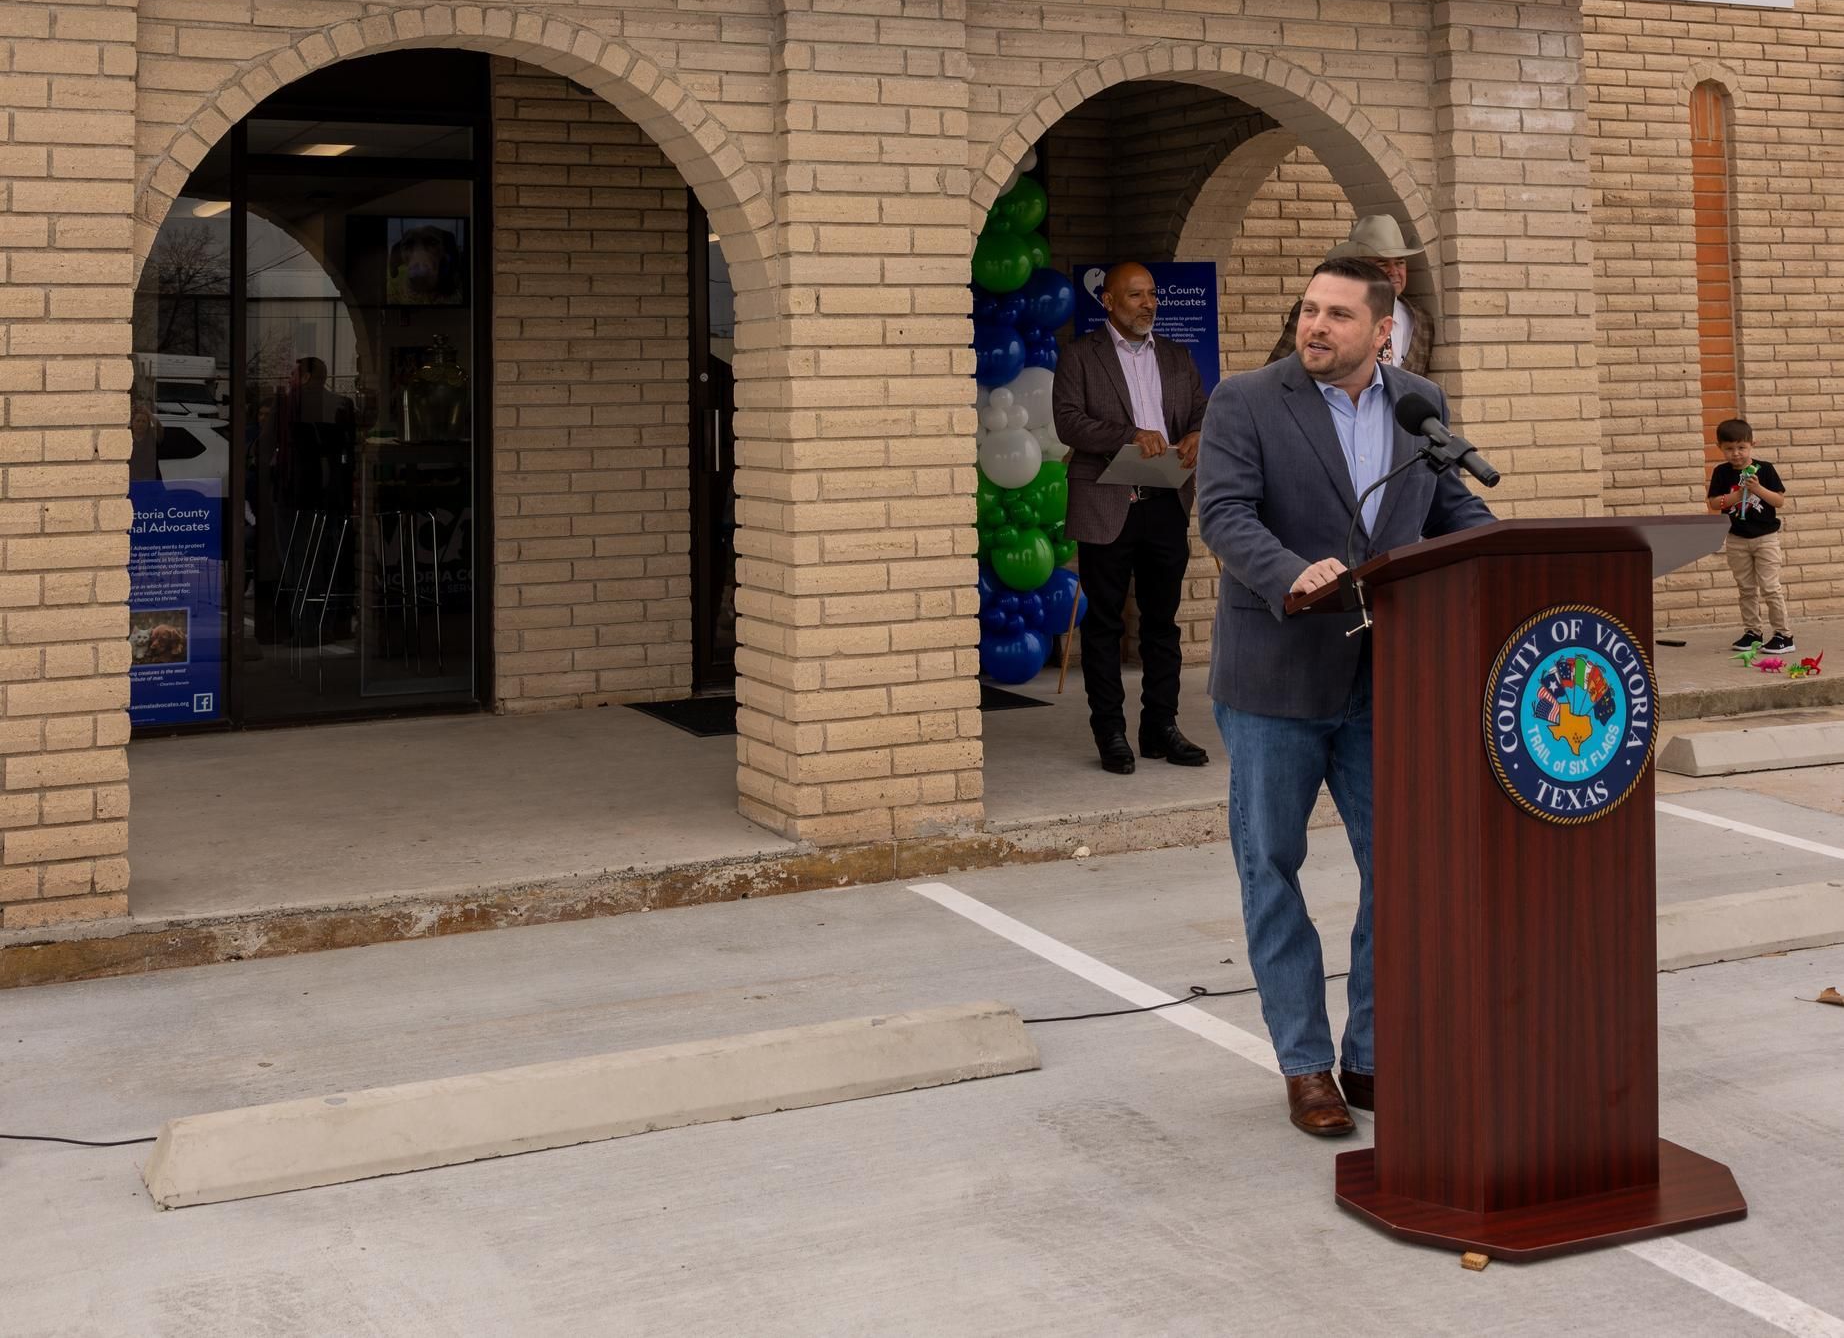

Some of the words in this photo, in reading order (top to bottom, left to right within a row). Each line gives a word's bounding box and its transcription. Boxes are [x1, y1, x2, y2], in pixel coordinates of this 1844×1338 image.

[1169, 285, 1206, 296] County
[1156, 296, 1206, 306] Advocates
[167, 508, 210, 519] County
[149, 521, 210, 532] Advocates
[1497, 634, 1542, 753] COUNTY
[1551, 618, 1583, 643] OF
[1595, 621, 1648, 749] VICTORIA
[1526, 725, 1551, 766] TRAIL
[1553, 761, 1566, 774] of
[1569, 757, 1590, 775] SIX
[1591, 723, 1620, 766] FLAGS
[1536, 779, 1609, 810] TEXAS
